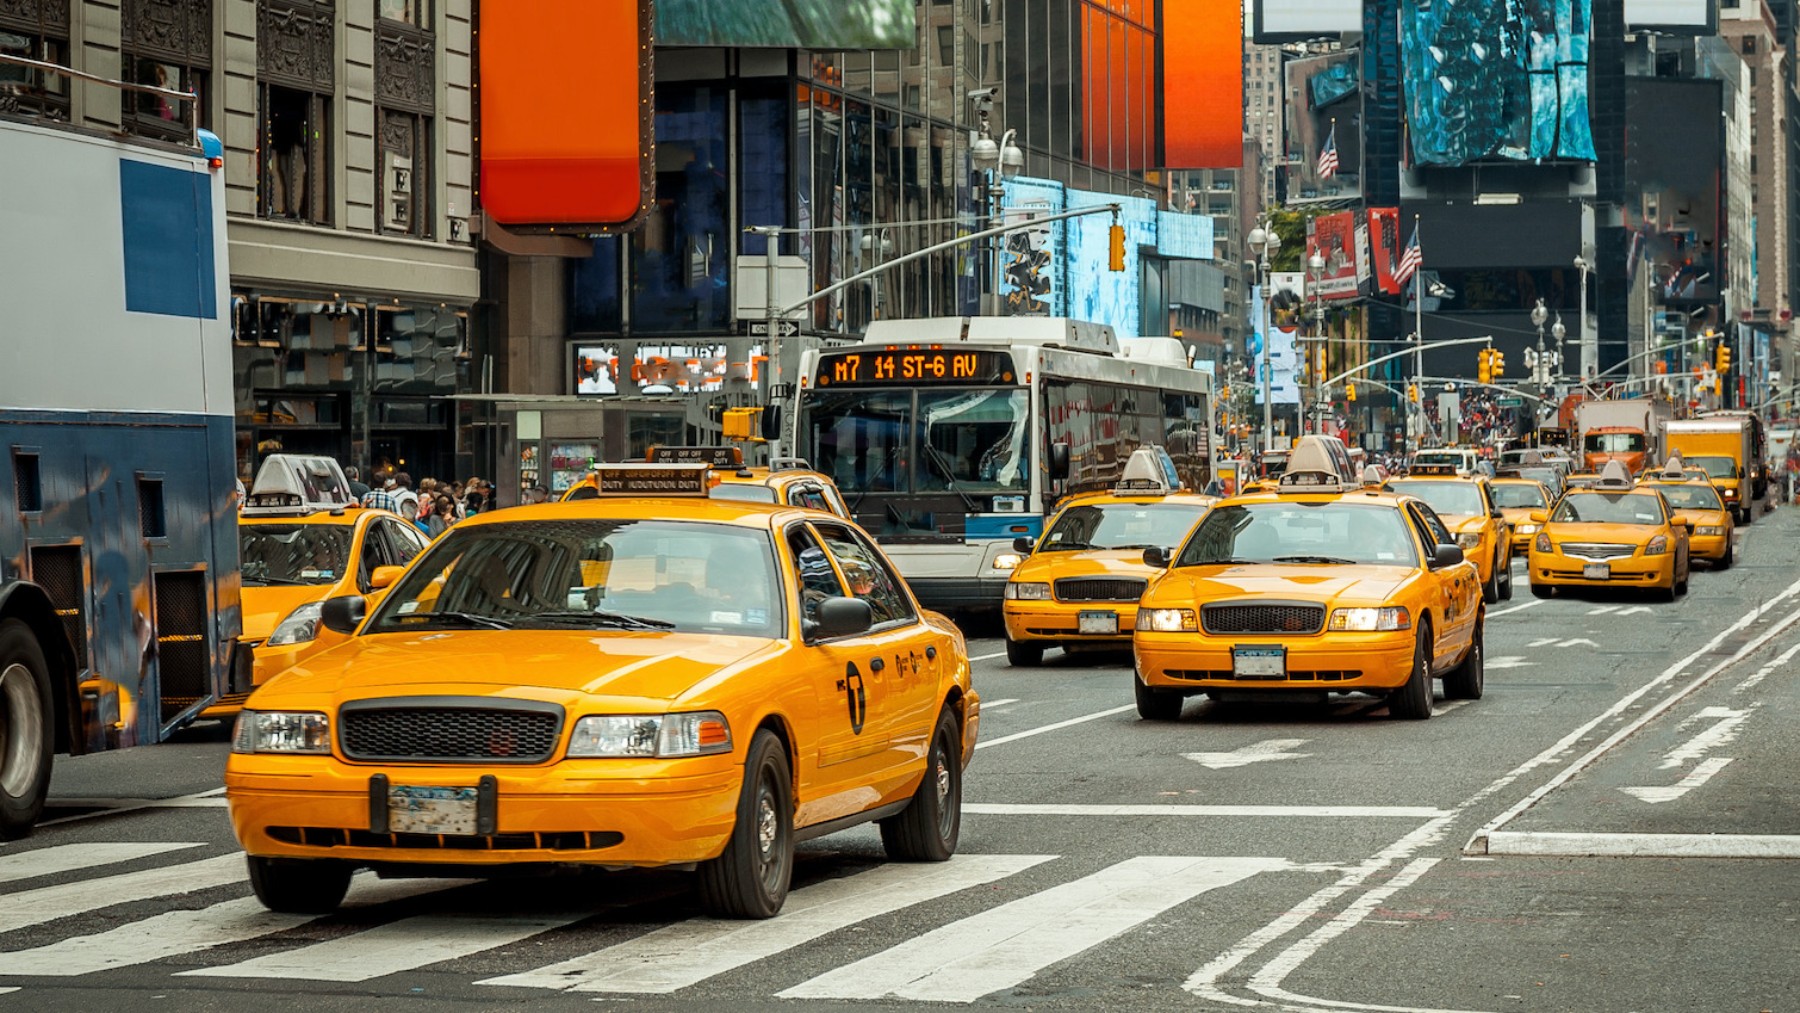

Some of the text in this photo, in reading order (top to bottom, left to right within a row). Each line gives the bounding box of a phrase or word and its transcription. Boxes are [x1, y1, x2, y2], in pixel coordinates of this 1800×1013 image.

[835, 354, 977, 381] M7 14 ST-6 AV
